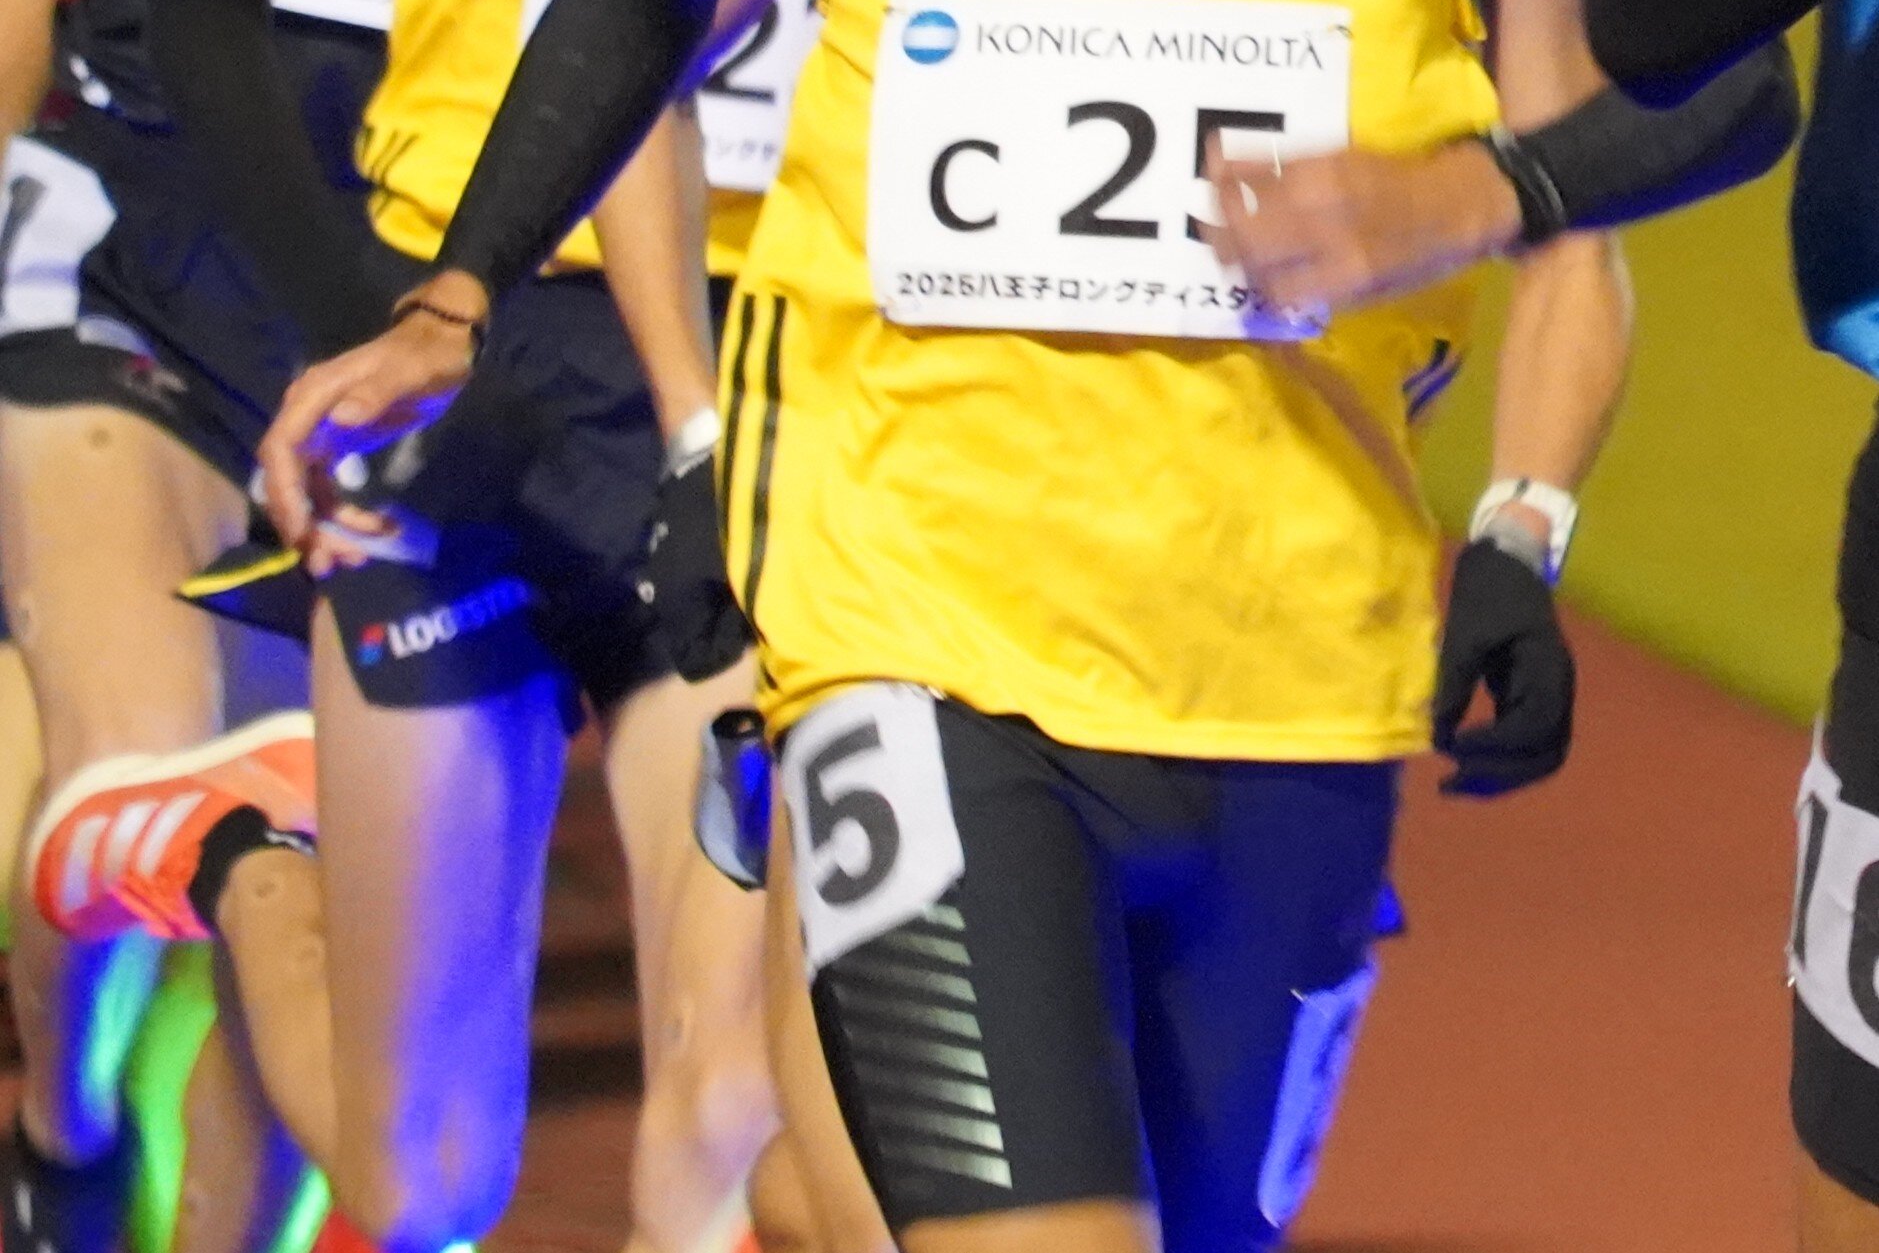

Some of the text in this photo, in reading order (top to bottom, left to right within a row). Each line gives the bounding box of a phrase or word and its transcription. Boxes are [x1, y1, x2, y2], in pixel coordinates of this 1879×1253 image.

[976, 21, 1325, 70] KONICA MINOLTA
[928, 138, 1002, 233] C
[804, 716, 900, 908] 5
